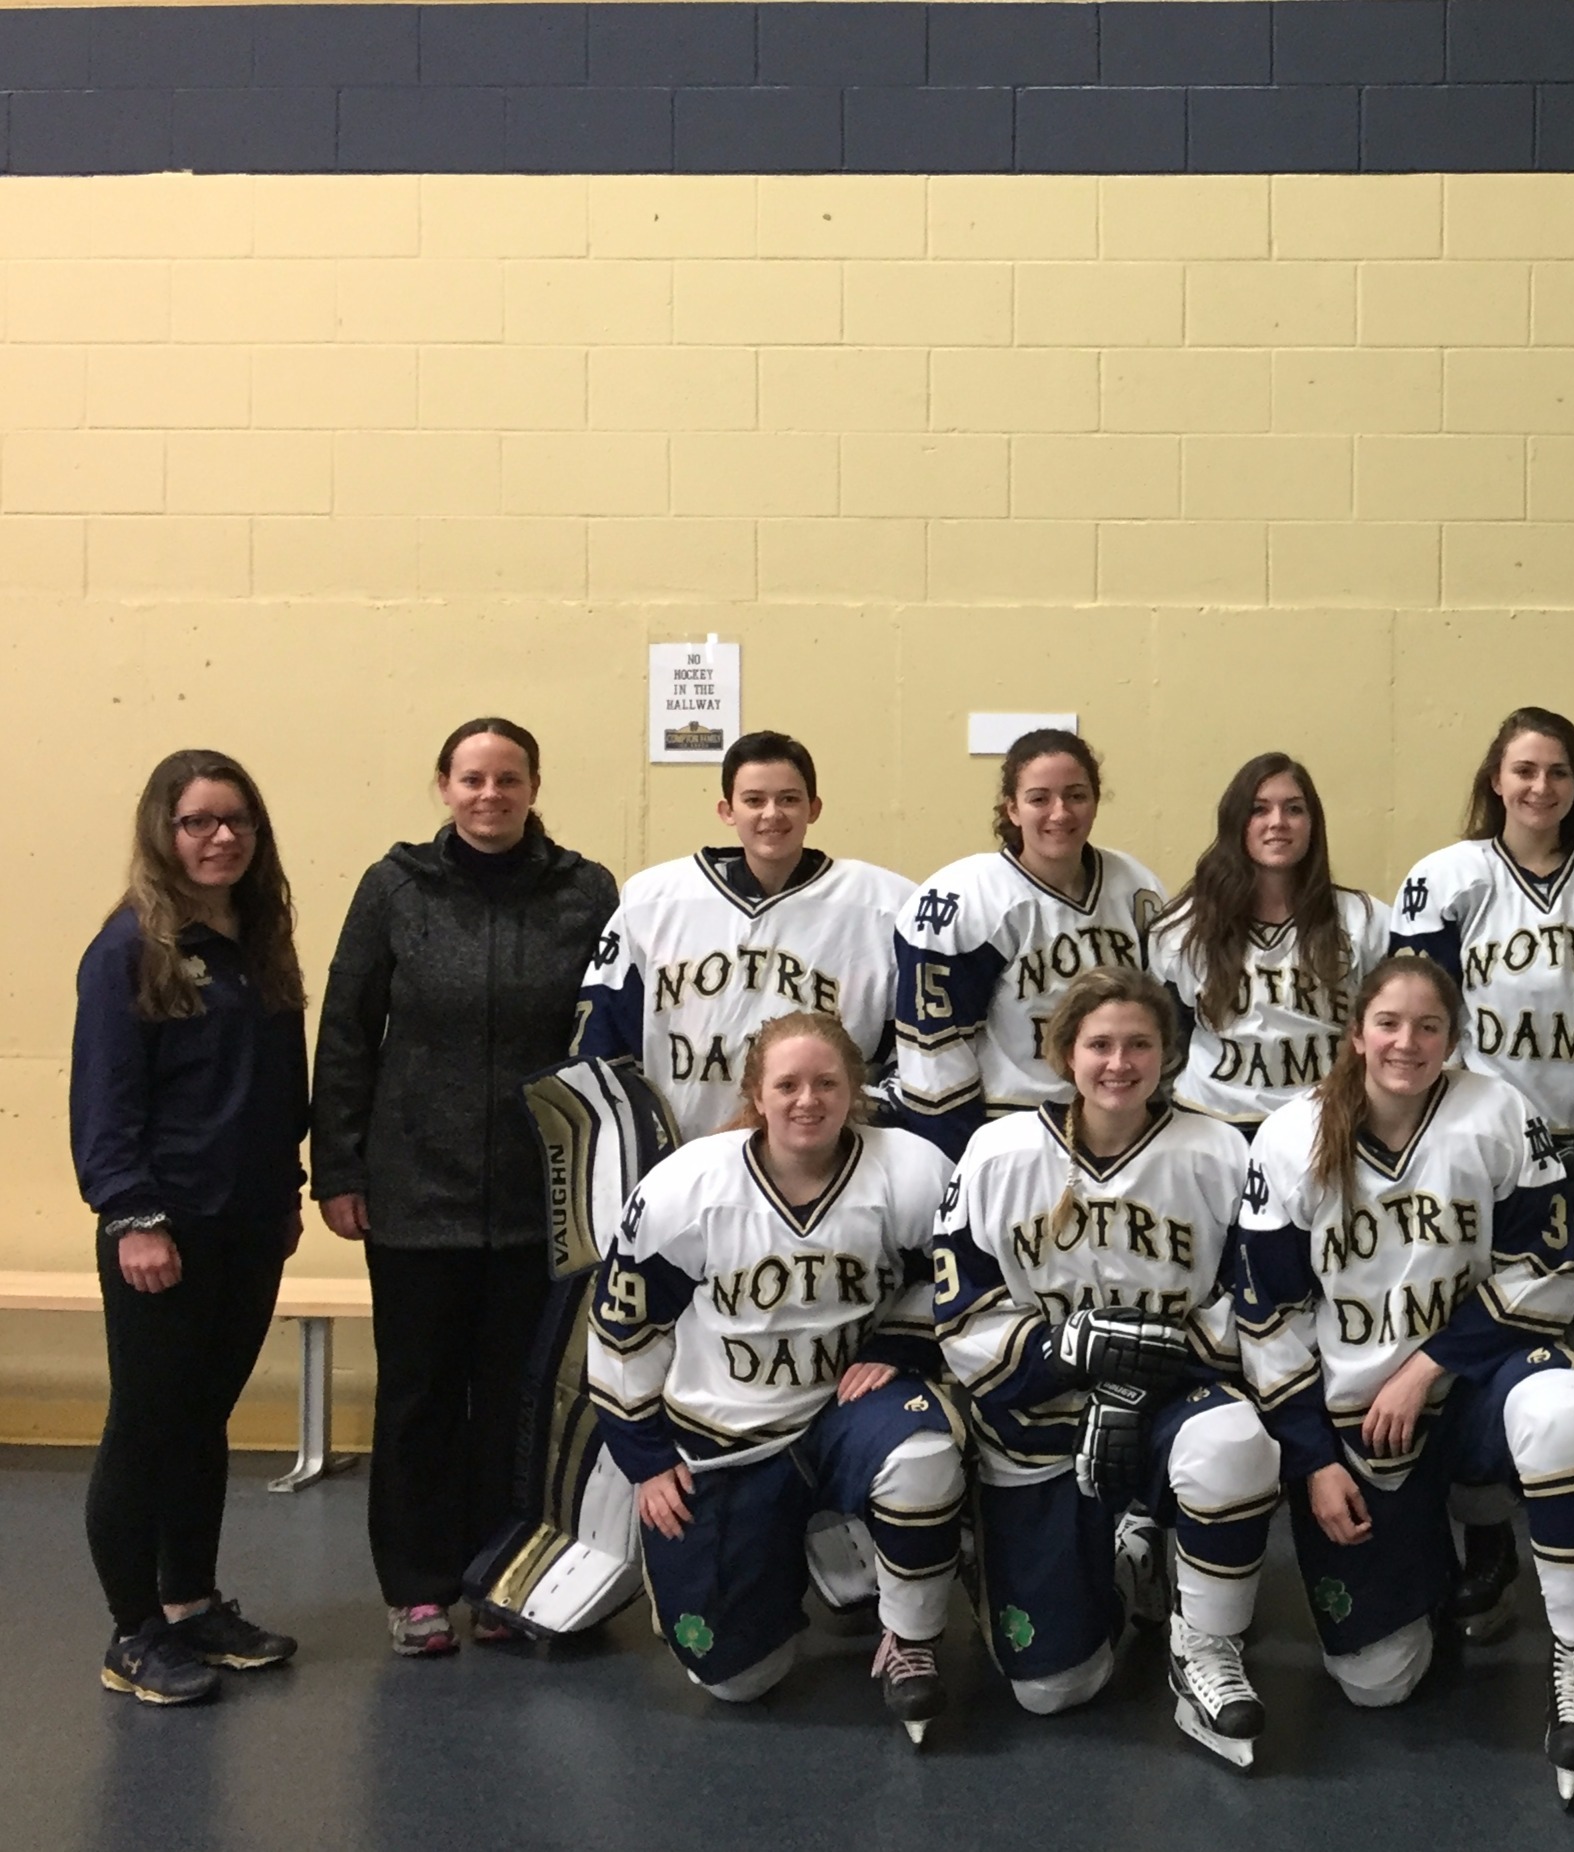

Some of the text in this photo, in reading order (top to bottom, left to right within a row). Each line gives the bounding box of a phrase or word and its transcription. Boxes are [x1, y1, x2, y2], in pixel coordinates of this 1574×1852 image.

[673, 669, 713, 680] HOCKEY
[673, 684, 715, 695] IN THE
[687, 654, 701, 665] NO
[666, 699, 721, 710] HALLWAY
[653, 944, 841, 1016] NOTRE
[1017, 926, 1138, 1000] NOTR
[668, 1032, 757, 1083] DA
[548, 1144, 570, 1267] VAUGHN
[1011, 1197, 1195, 1271] NOTRE
[1320, 1191, 1479, 1274] NOTRE
